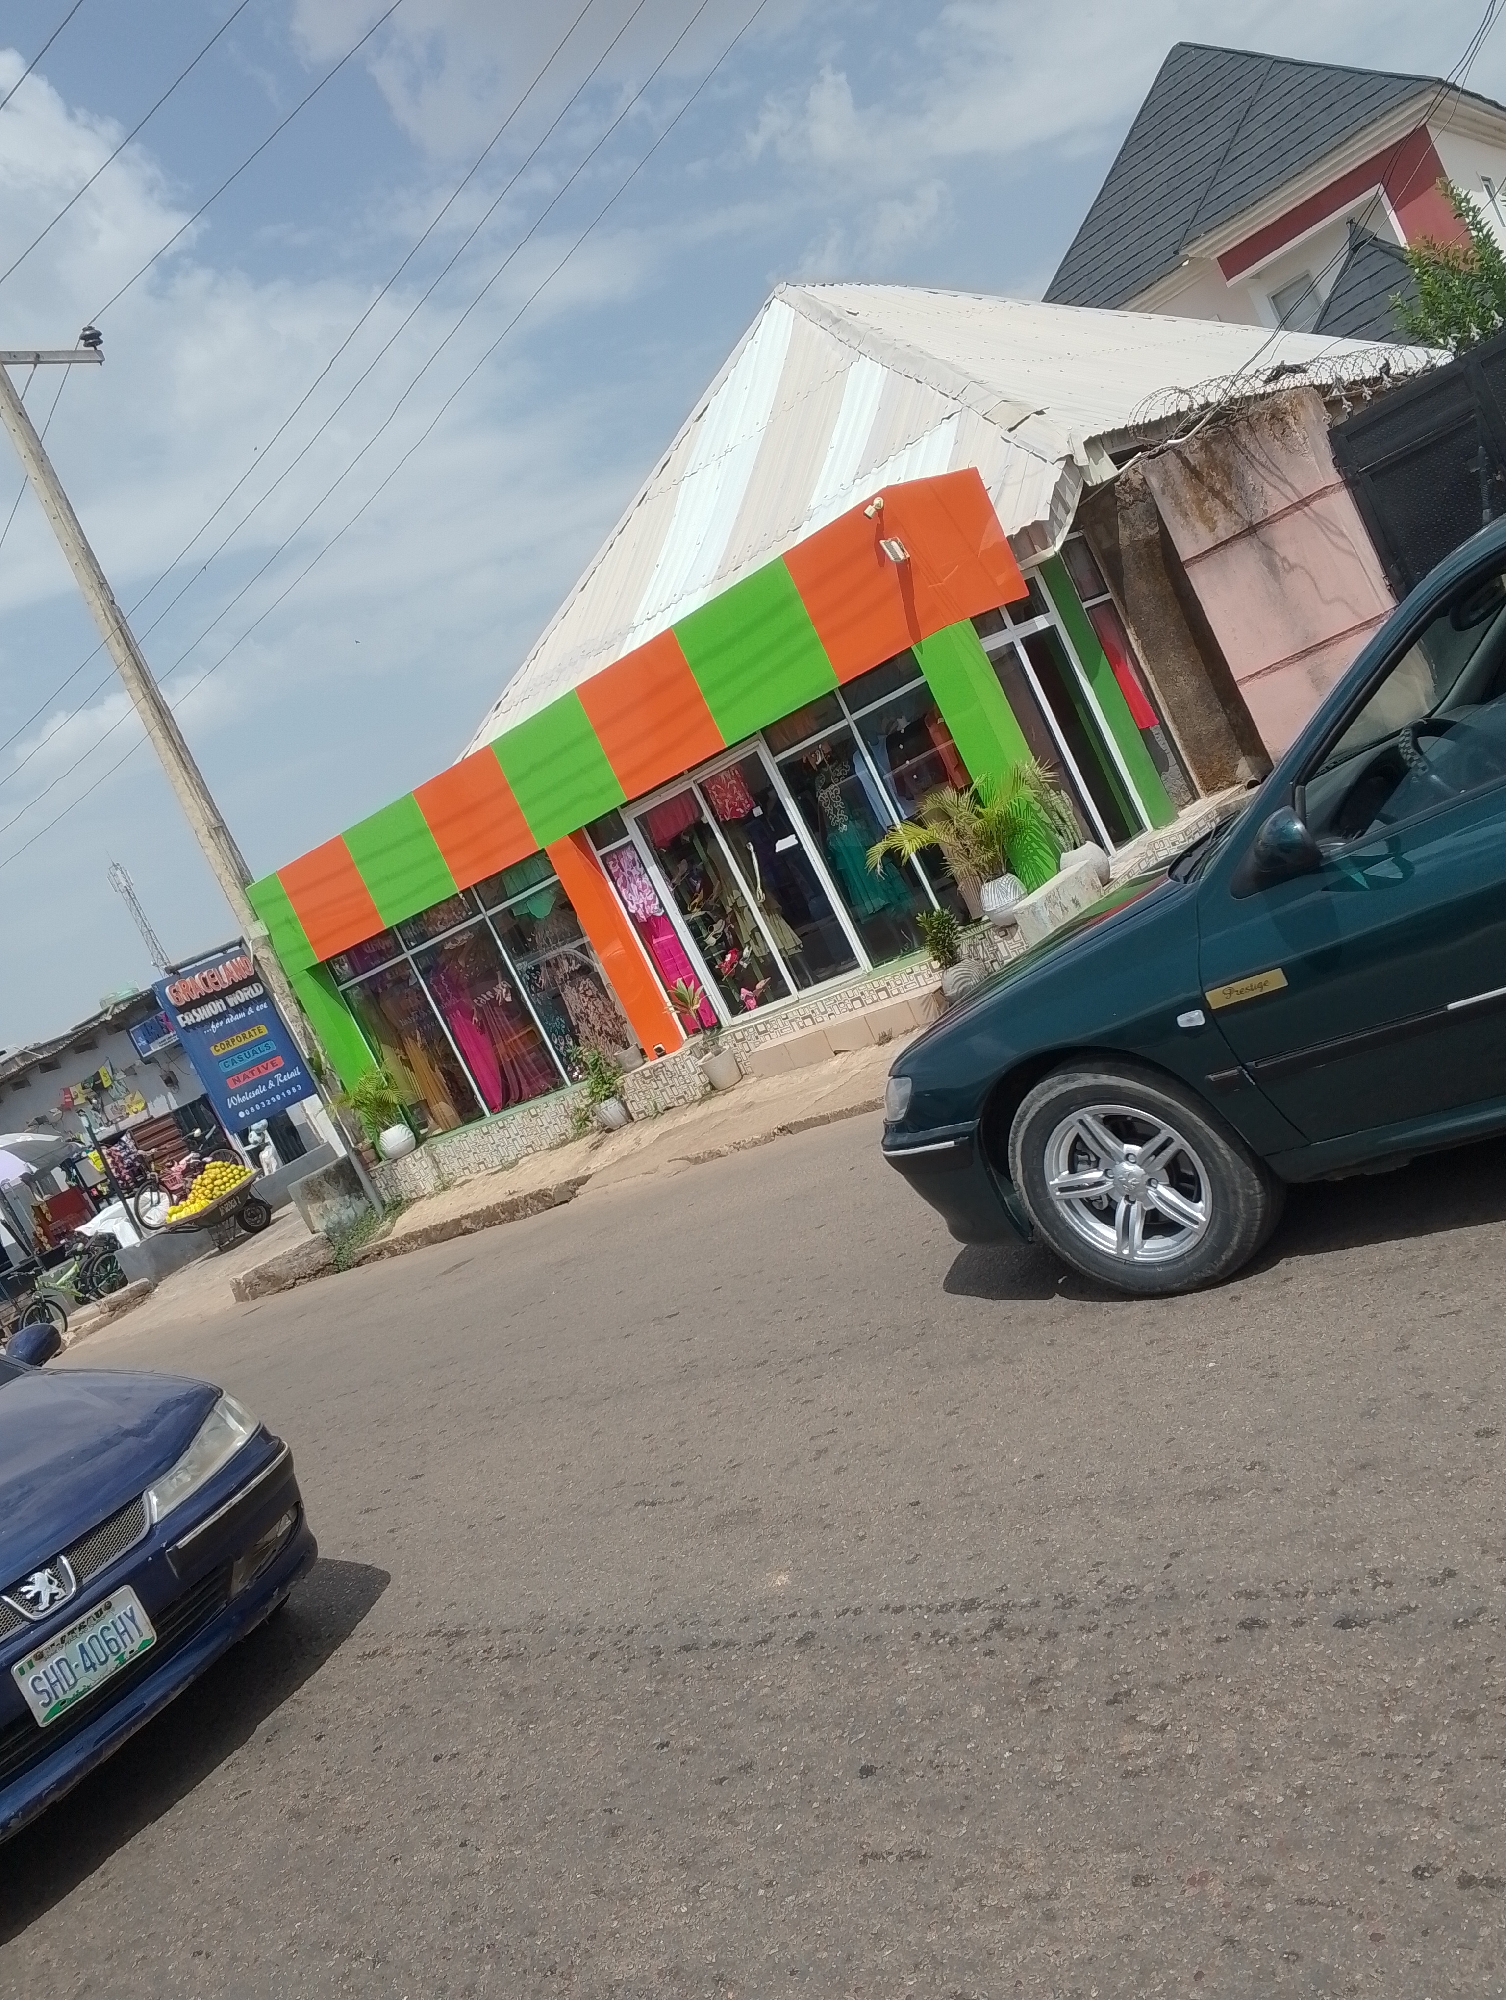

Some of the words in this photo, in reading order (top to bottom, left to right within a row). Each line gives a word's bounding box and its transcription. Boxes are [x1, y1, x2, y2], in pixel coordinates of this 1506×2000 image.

[166, 956, 254, 1006] GRACELAND
[1222, 979, 1269, 999] Prestige
[176, 997, 226, 1028] FASHION
[228, 982, 264, 1008] WORLD
[226, 1012, 246, 1025] adam
[247, 1007, 255, 1016] &
[213, 1026, 264, 1053] CORPORATE
[223, 1043, 272, 1069] CASUALS
[231, 1059, 279, 1086] NATIVE
[226, 1086, 268, 1109] Wholesale
[268, 1080, 276, 1092] &
[276, 1066, 302, 1088] Retail
[29, 1605, 143, 1707] SHD-406HY
